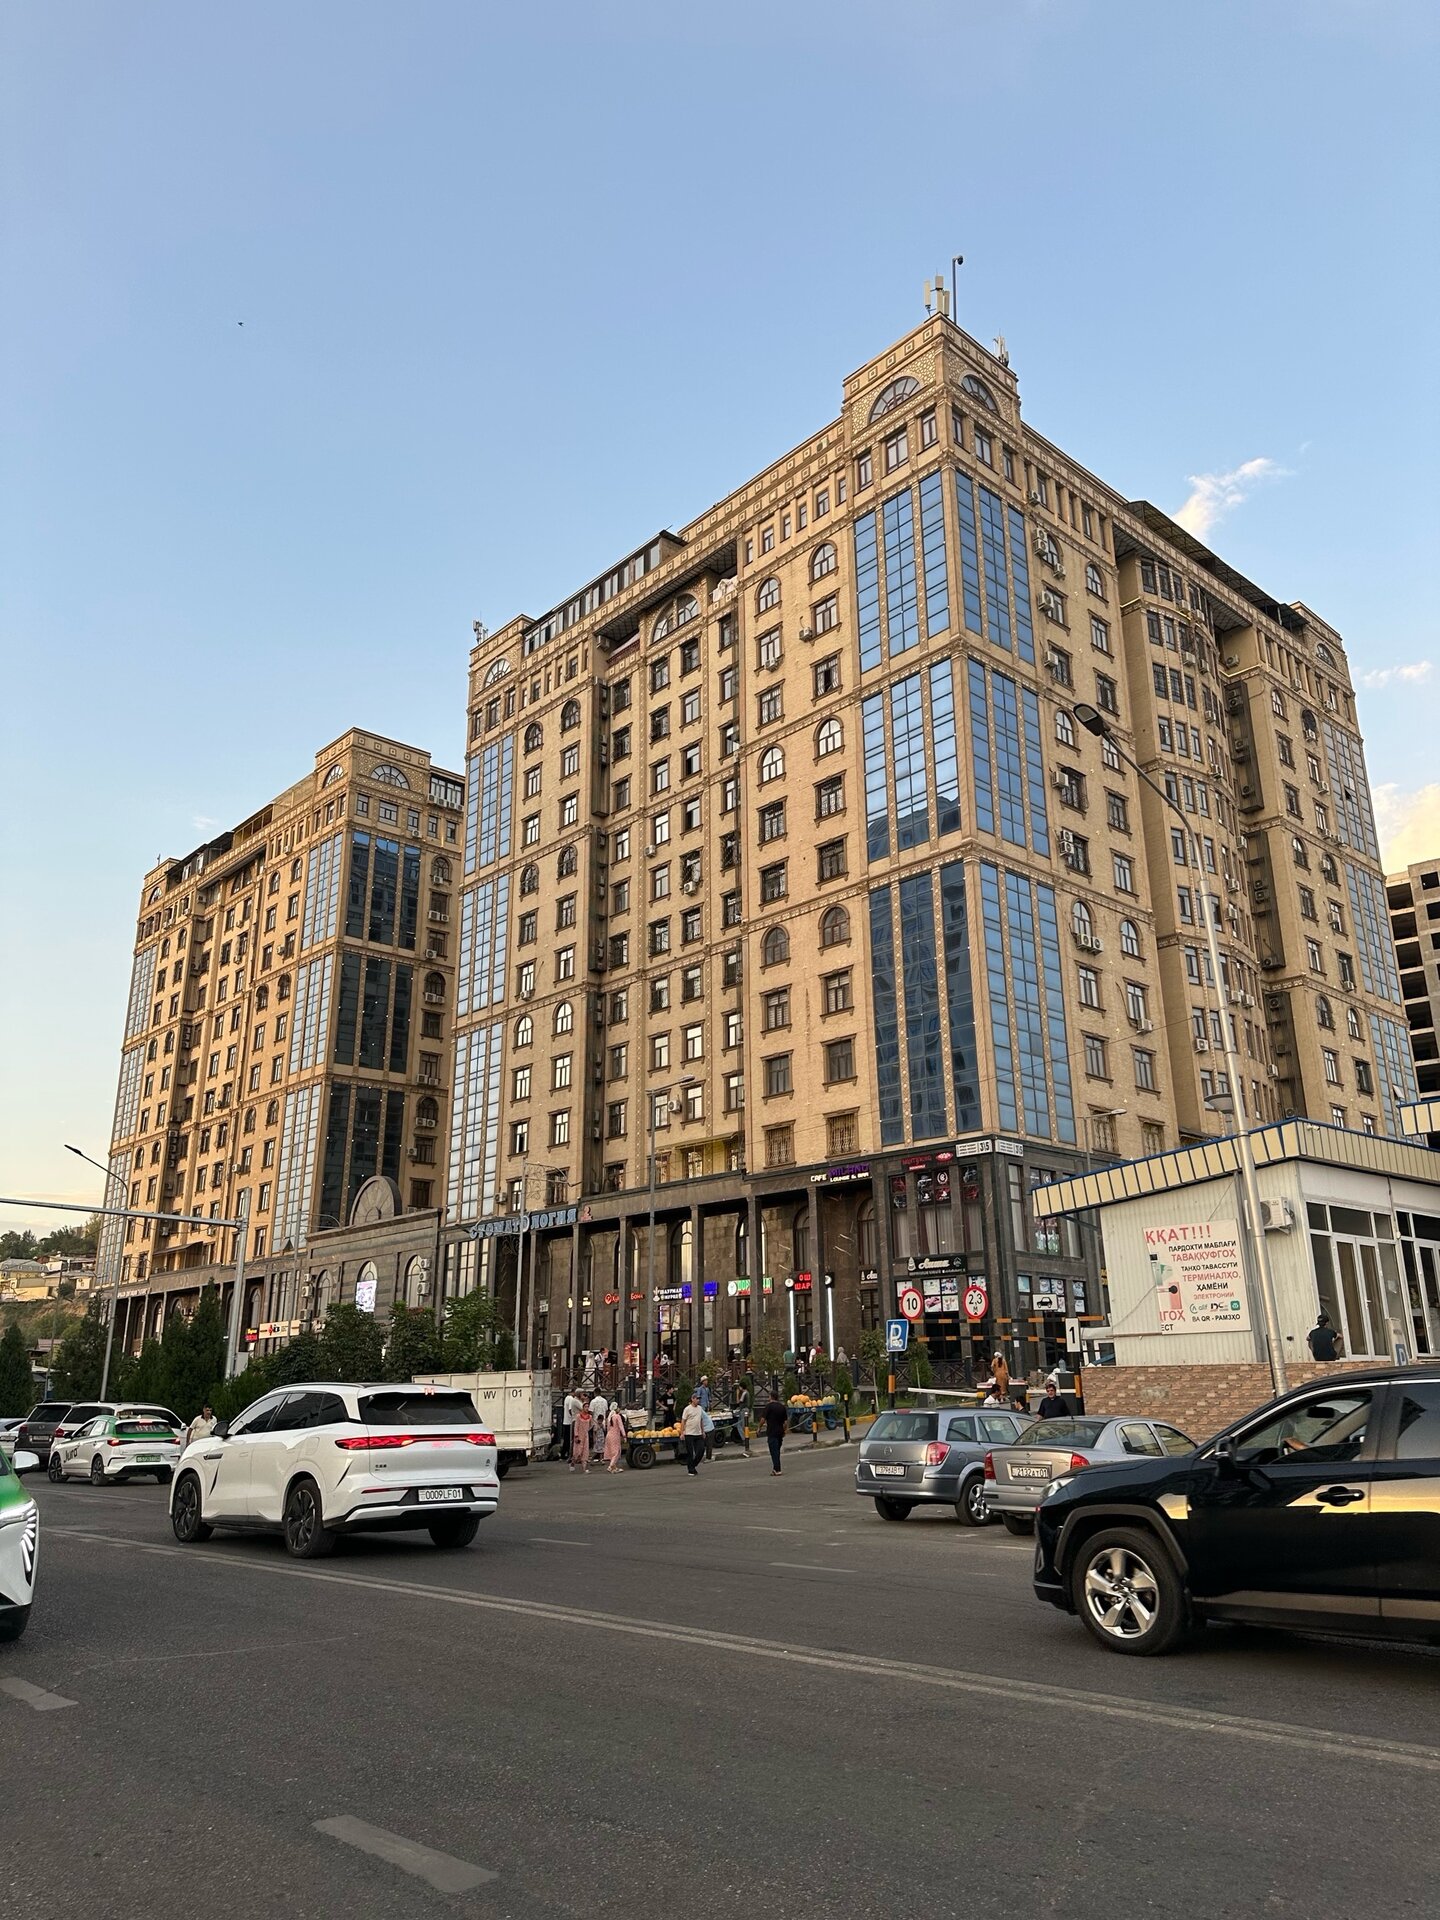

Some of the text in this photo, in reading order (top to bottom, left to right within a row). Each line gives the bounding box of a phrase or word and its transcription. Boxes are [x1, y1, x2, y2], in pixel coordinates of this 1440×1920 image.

[810, 1173, 827, 1182] CAFE
[830, 1174, 850, 1182] LOUNGE
[469, 1208, 577, 1238] СТОМАТОЛОГИЯ
[1168, 1243, 1203, 1252] ПАРДОХТИ
[1202, 1262, 1238, 1270] ТАВАССУТИ
[906, 1298, 918, 1311] 10
[1069, 1326, 1075, 1344] 1
[483, 1389, 522, 1399] WV 01
[425, 1488, 461, 1500] 0009LF01
